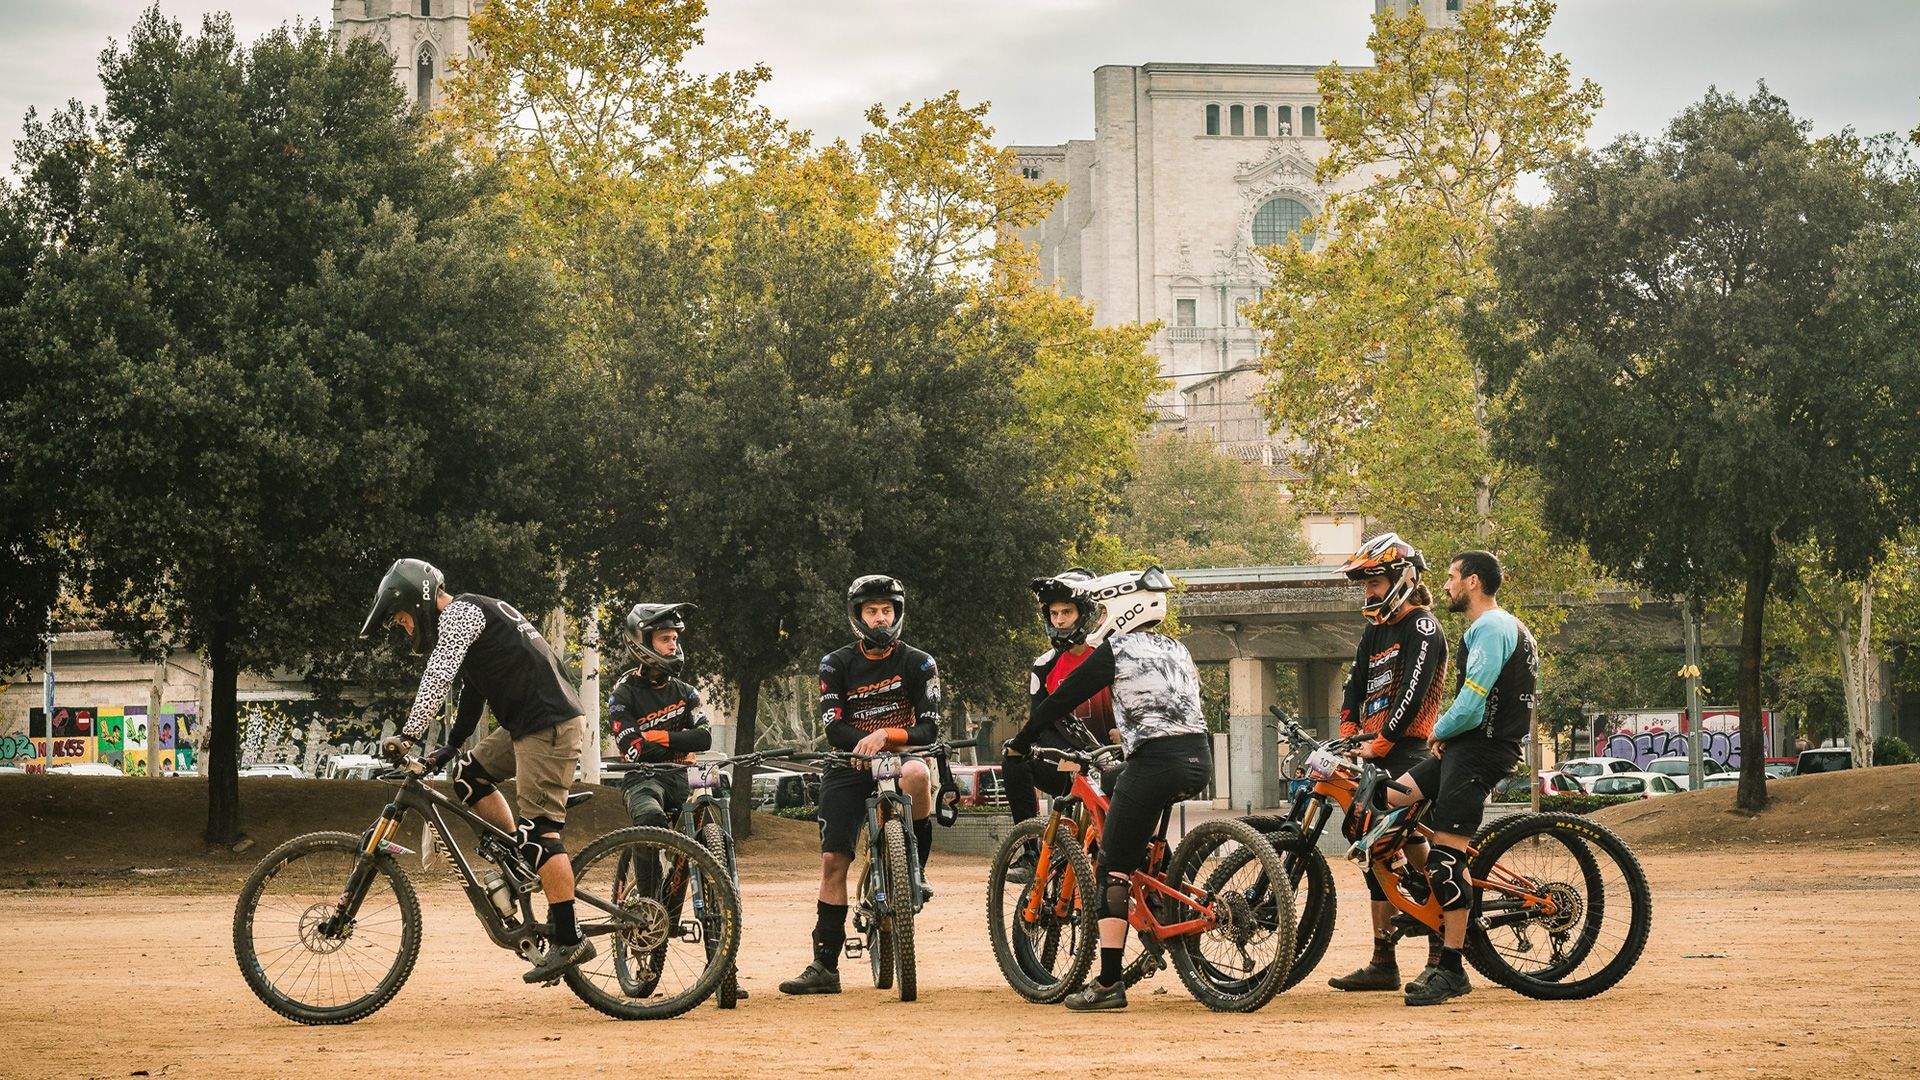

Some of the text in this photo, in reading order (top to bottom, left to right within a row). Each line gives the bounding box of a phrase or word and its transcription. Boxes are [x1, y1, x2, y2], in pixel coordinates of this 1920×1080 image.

[422, 579, 431, 601] poc
[1115, 603, 1145, 629] poc
[1388, 640, 1430, 731] MONDRAKER
[1319, 757, 1330, 768] 10
[1555, 820, 1601, 840] MAXXIS
